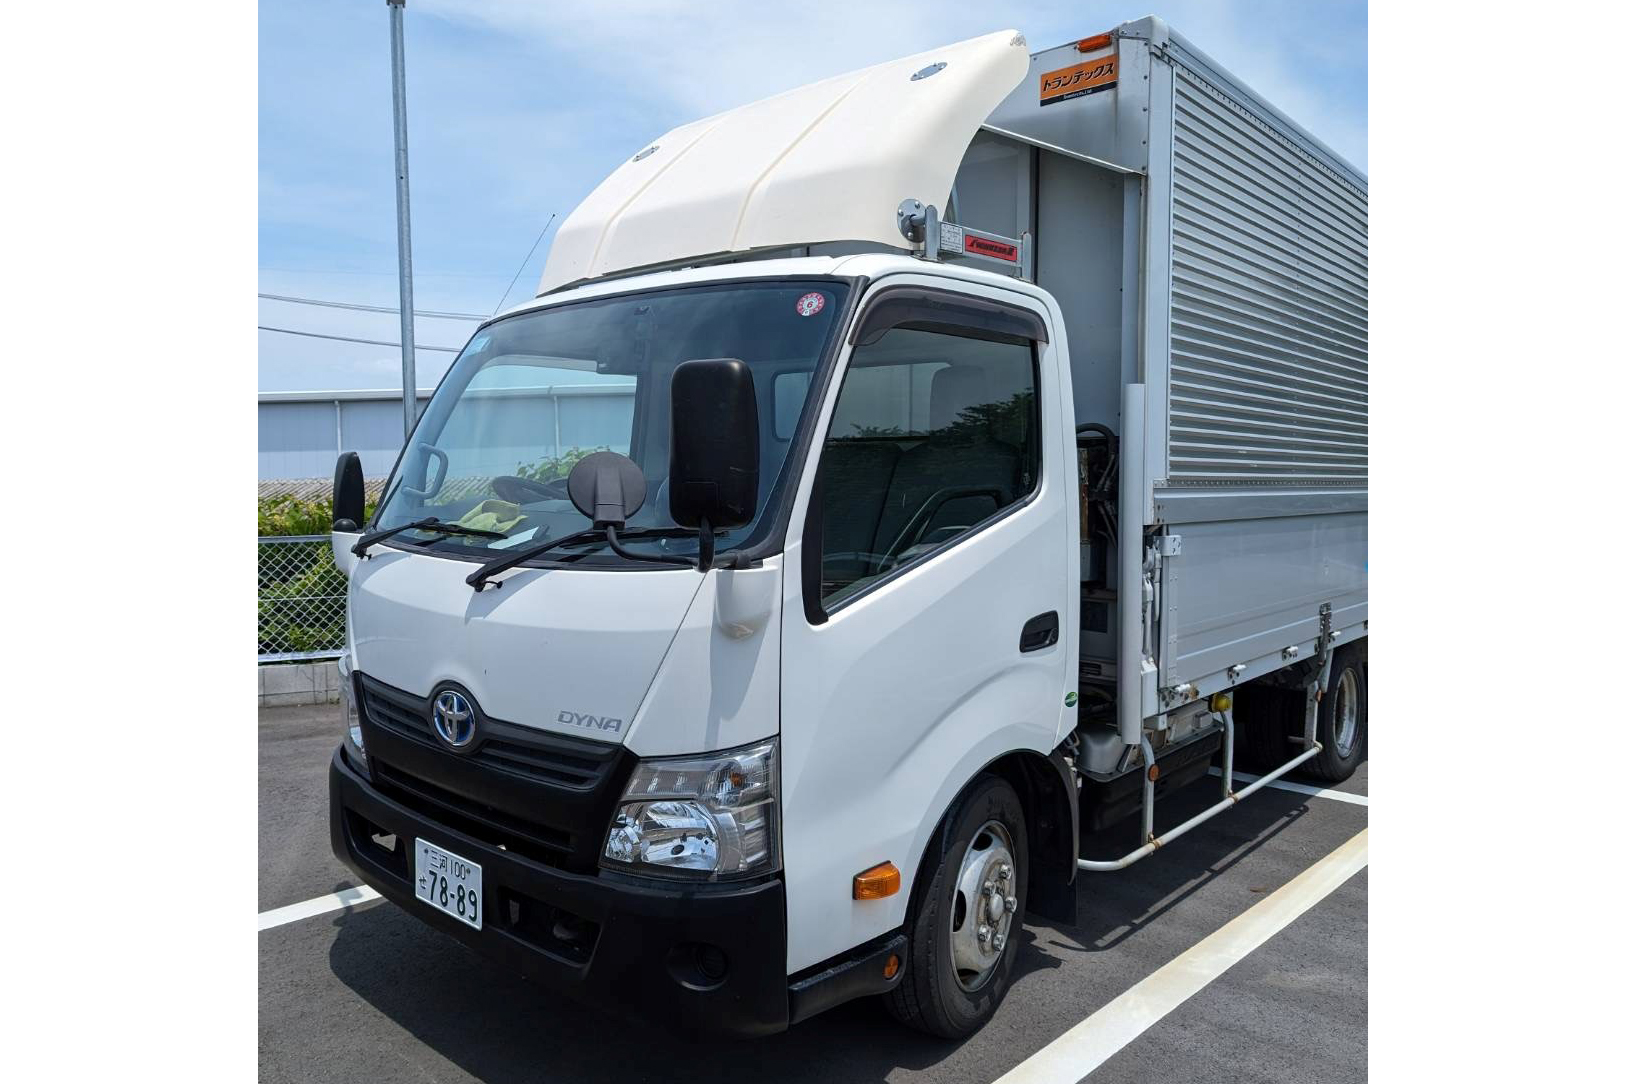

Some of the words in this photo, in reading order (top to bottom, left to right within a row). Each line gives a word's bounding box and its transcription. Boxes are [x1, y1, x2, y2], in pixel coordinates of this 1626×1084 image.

[1043, 62, 1114, 92] トランテックス
[558, 710, 622, 732] DYNA
[428, 868, 478, 922] 78-89
